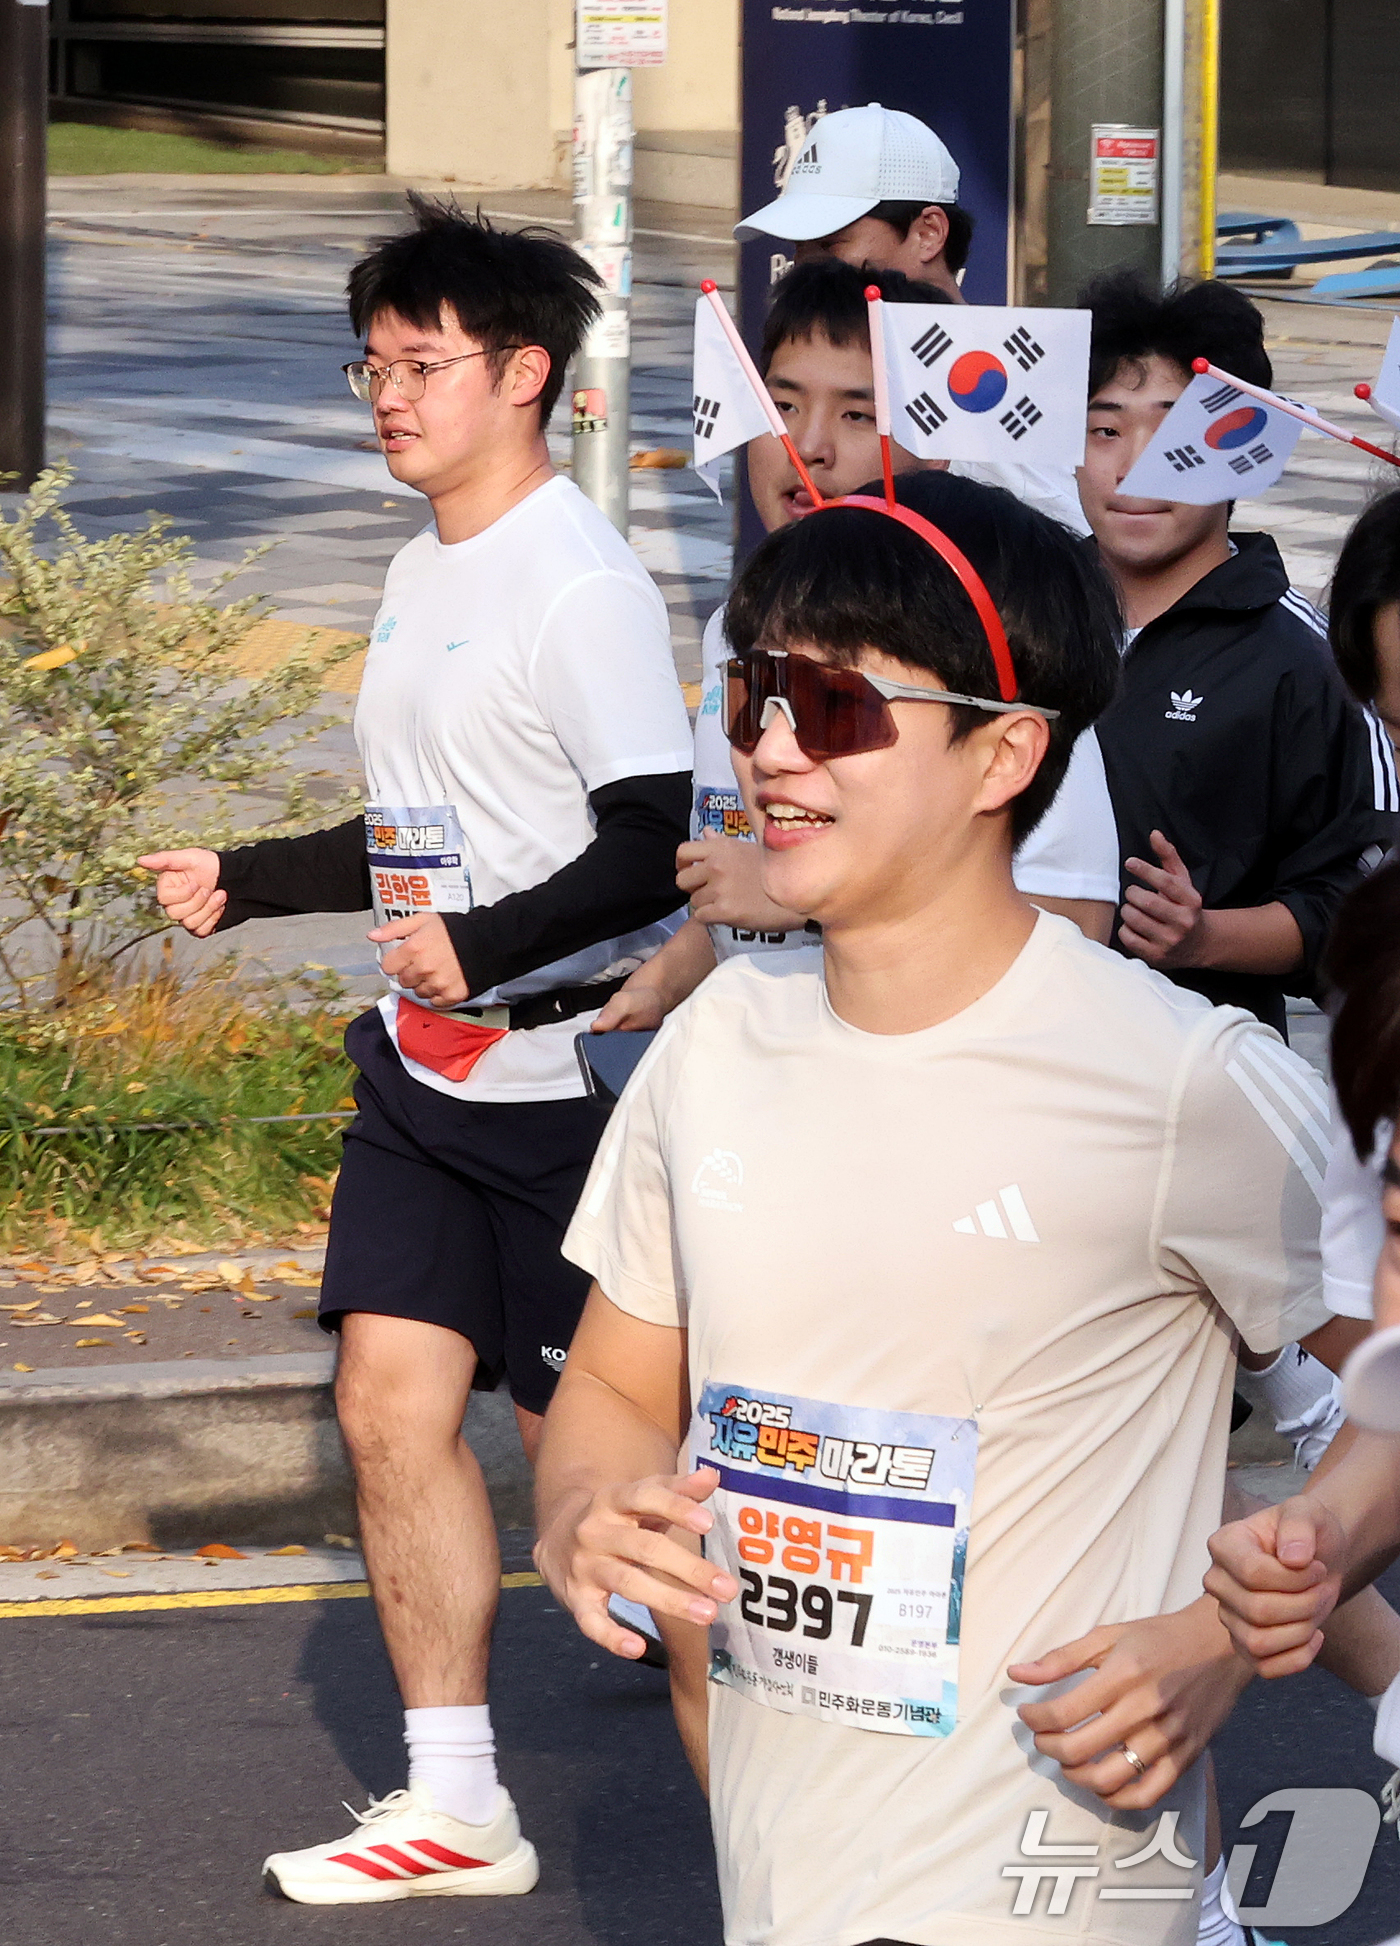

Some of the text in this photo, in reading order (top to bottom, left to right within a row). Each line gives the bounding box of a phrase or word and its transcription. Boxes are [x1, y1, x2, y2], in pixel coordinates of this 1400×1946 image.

[1165, 711, 1196, 721] adidas
[708, 794, 738, 810] 2025
[397, 824, 445, 851] 마라톤
[736, 1397, 792, 1429] 2025
[709, 1411, 937, 1491] 자유민주 마라톤
[737, 1506, 876, 1584] 양영규
[738, 1566, 874, 1648] 2397
[898, 1603, 933, 1619] B197
[771, 1646, 819, 1676] 갱생이들
[818, 1691, 941, 1726] 민주화운동기념관
